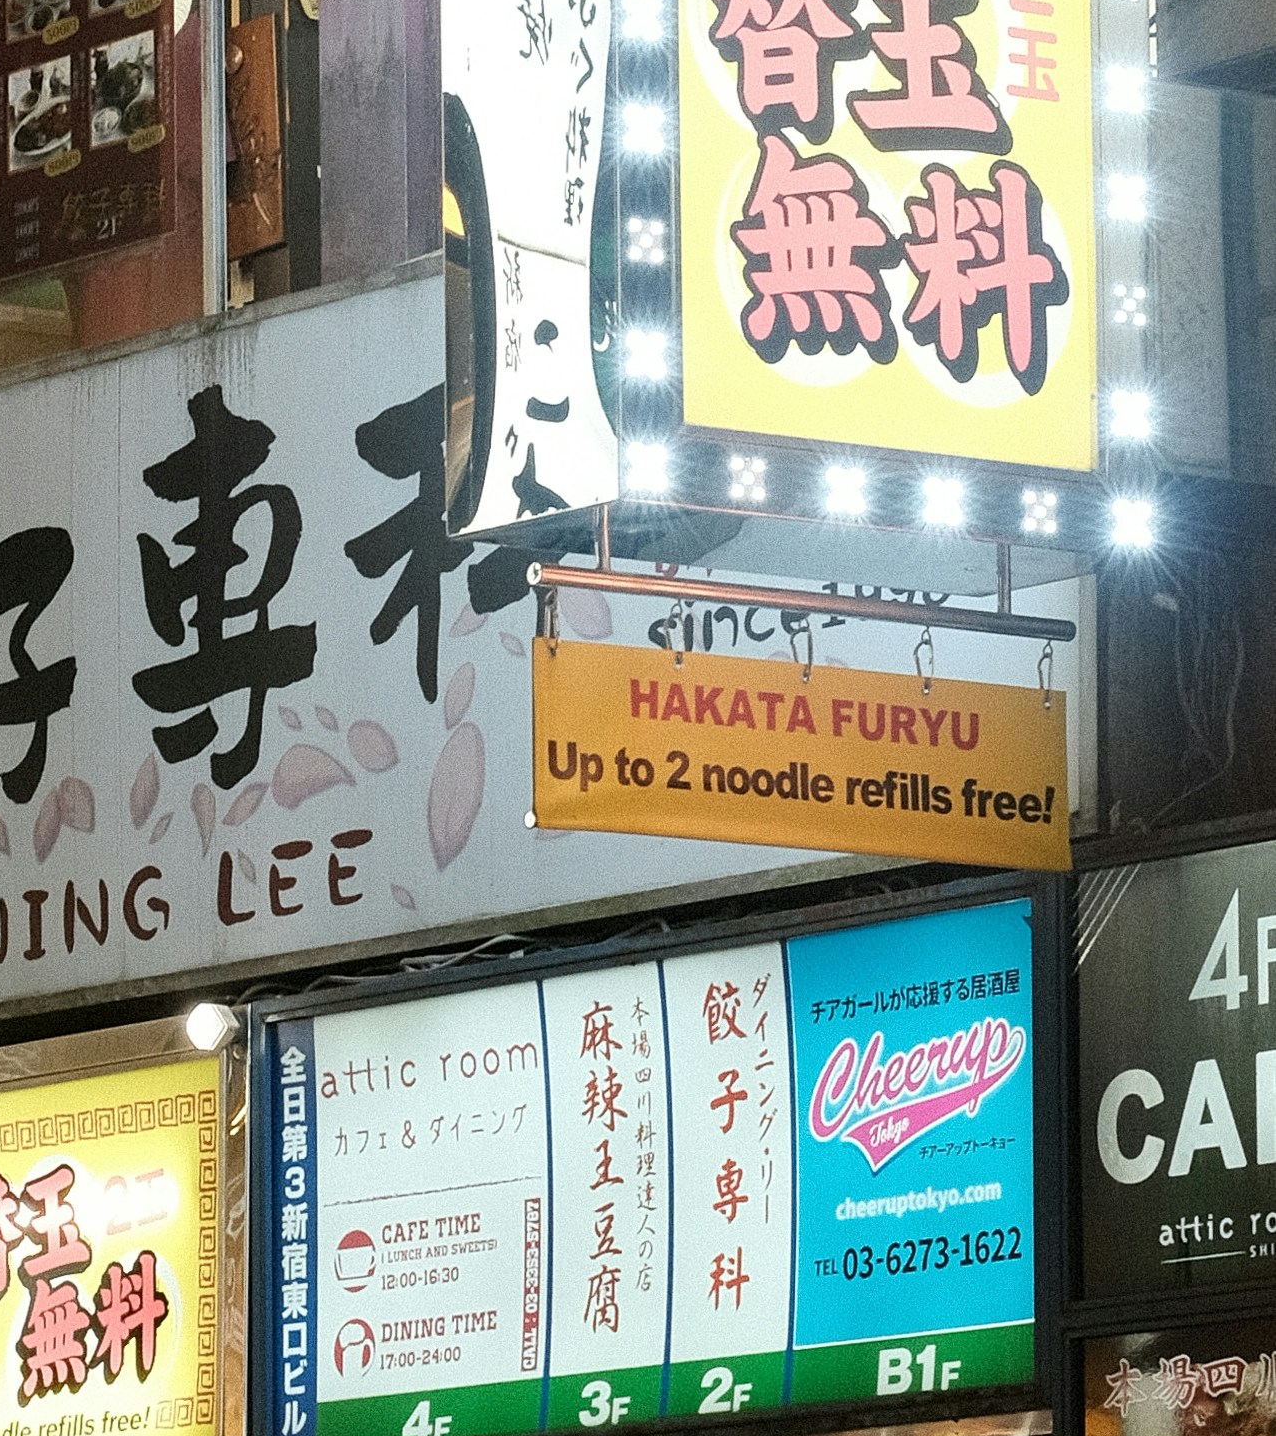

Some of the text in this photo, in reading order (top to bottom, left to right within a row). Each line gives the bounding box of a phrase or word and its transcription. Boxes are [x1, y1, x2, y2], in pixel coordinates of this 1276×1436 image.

[729, 132, 1070, 395] 無料
[629, 677, 981, 752] HAKATA FURYU
[547, 739, 1056, 825] Up to 2 noodle refills free!
[217, 829, 374, 927] LEE
[810, 968, 1020, 1024] チアガールが応援する居酒屋
[320, 1041, 539, 1099] attic room
[808, 1016, 1027, 1143] Cheerup
[334, 1103, 527, 1157] カフェ & ダイニング
[631, 996, 658, 1292] 本場四川料理達人の店
[702, 980, 750, 1312] 餃子専科
[579, 999, 629, 1334] 麻辣王豆腐
[381, 1212, 482, 1245] CAFE TIME
[835, 1181, 1002, 1221] cheeruptokyo.com
[280, 1045, 309, 1436] 全日第3新宿東口ビル
[425, 1244, 448, 1259] AND
[814, 1225, 1023, 1282] TEL 03-6273-1622
[1159, 1215, 1235, 1247] attic
[380, 1265, 460, 1291] 12:00-16:30
[15, 1249, 170, 1408] 無料
[381, 1310, 498, 1343] DINING TIME
[379, 1345, 462, 1371] 17:00-24:00
[876, 1344, 962, 1397] B1F
[578, 1379, 631, 1427] 3F
[697, 1366, 753, 1415] 2F
[101, 1406, 150, 1434] free!
